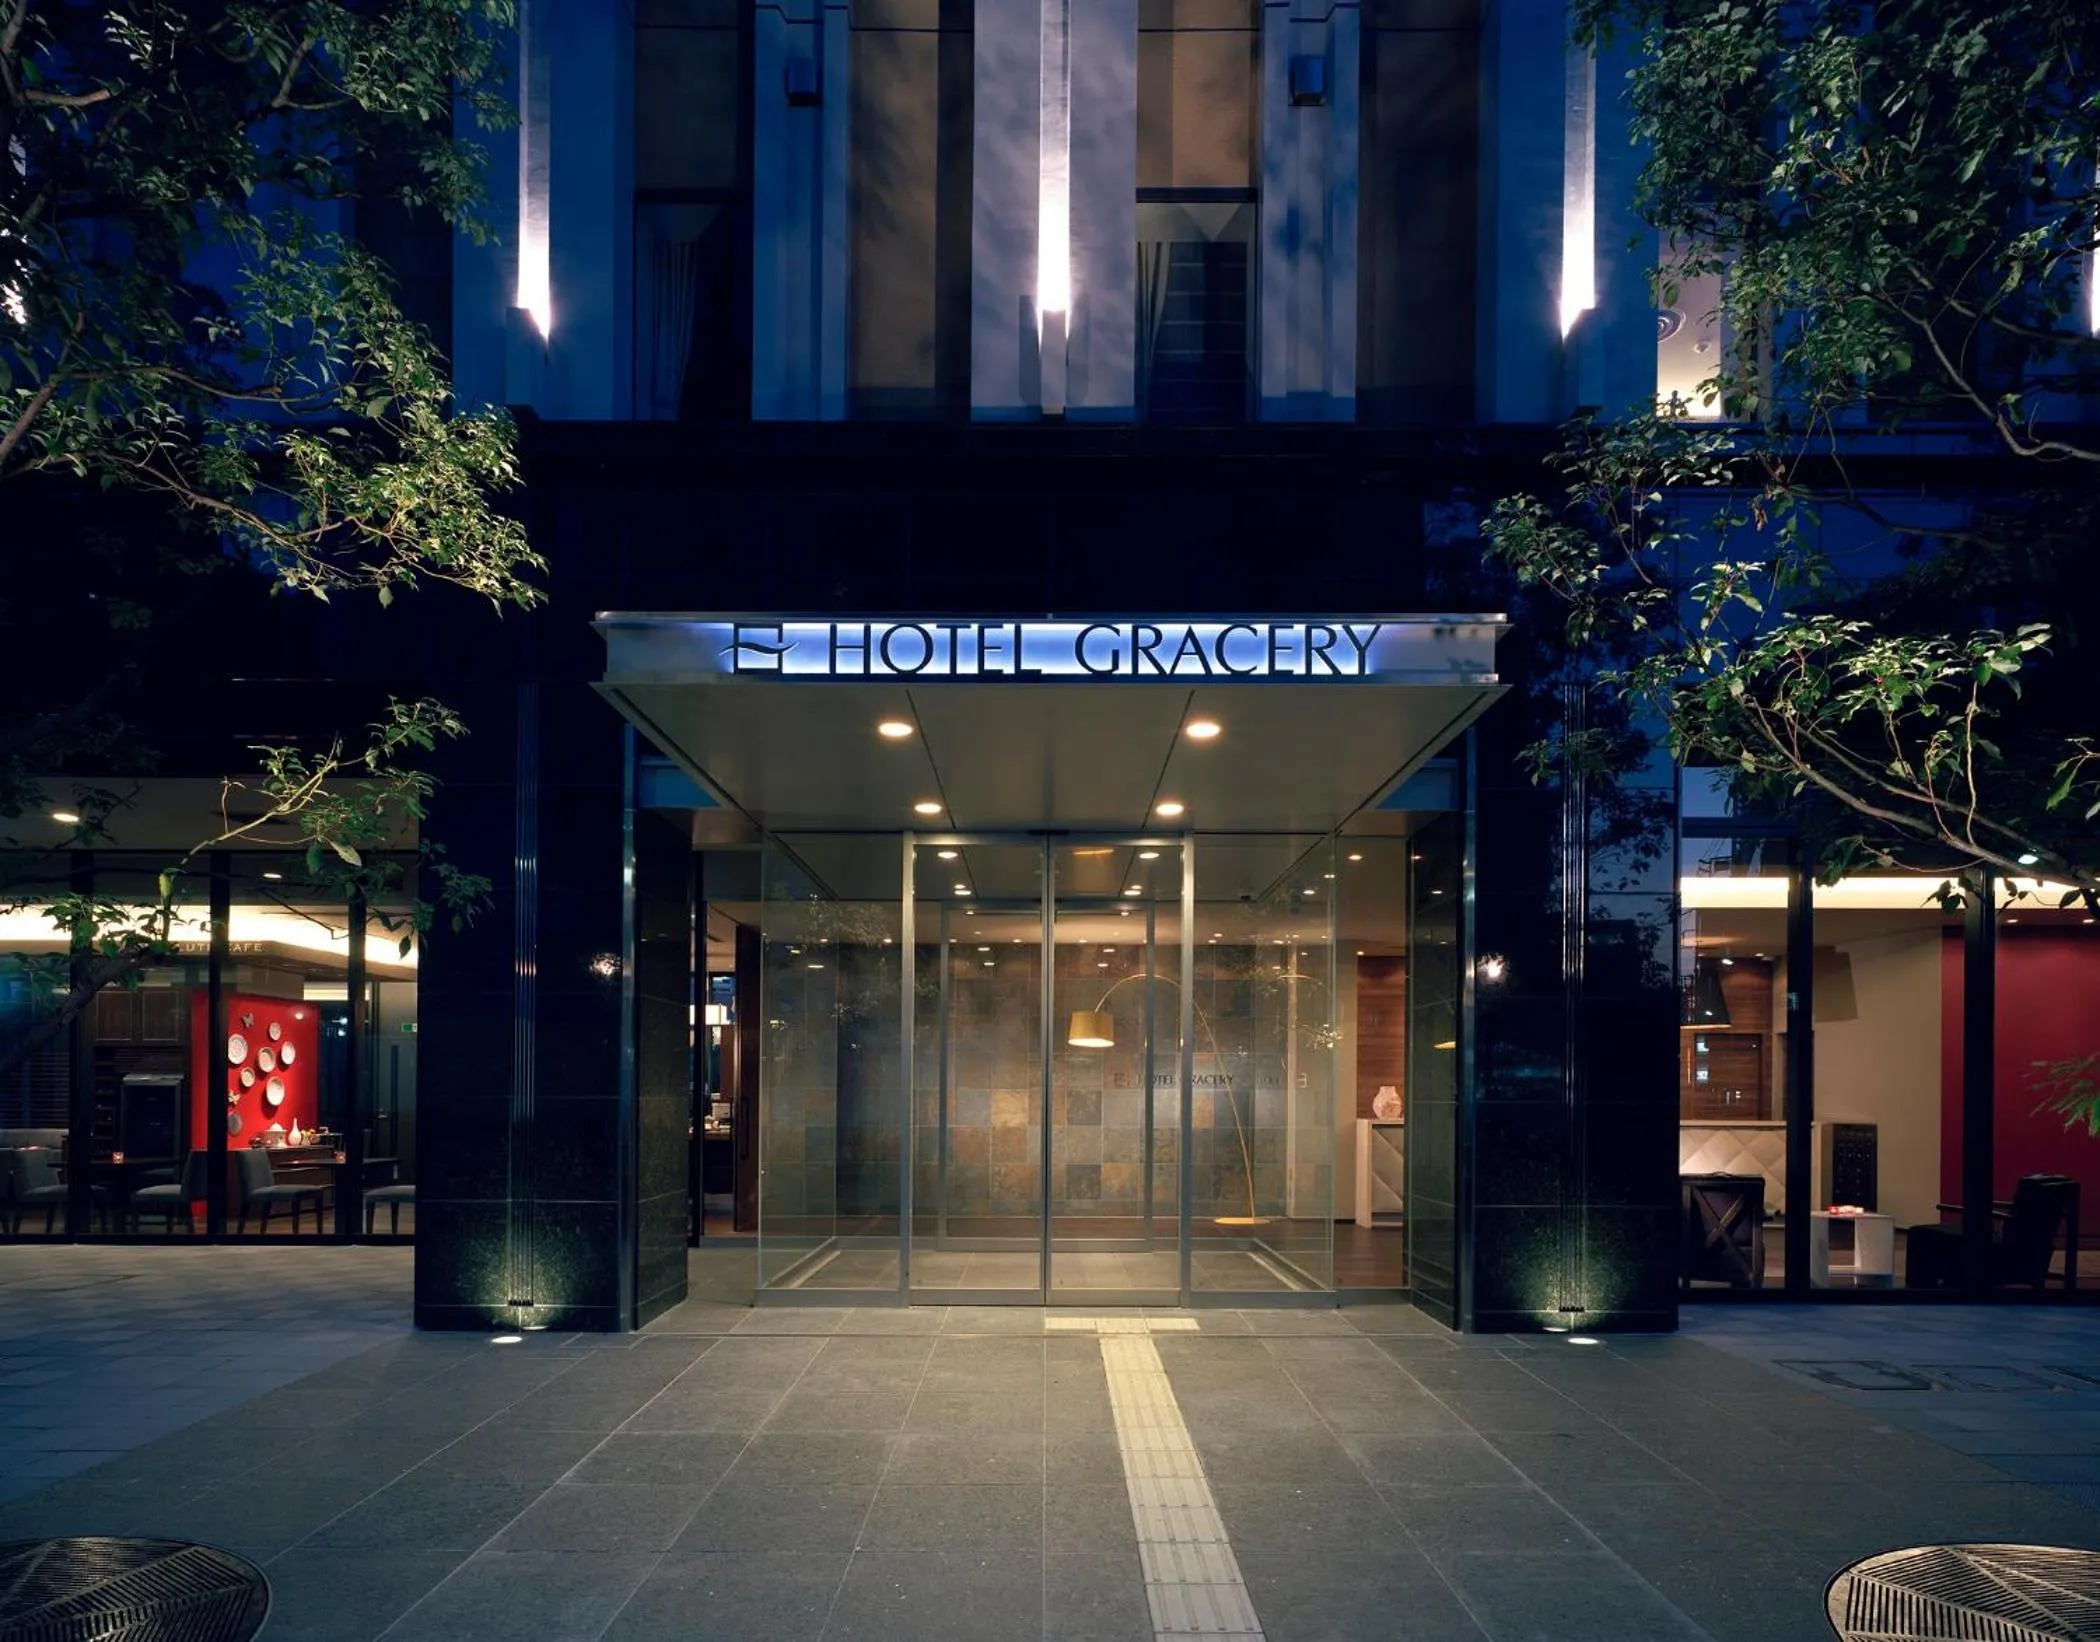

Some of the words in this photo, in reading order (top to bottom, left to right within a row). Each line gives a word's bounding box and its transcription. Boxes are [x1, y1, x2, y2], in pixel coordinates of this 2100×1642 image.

[829, 622, 1042, 675] HOTEL
[1074, 623, 1382, 675] GRACERY
[1180, 1073, 1234, 1085] RACERY
